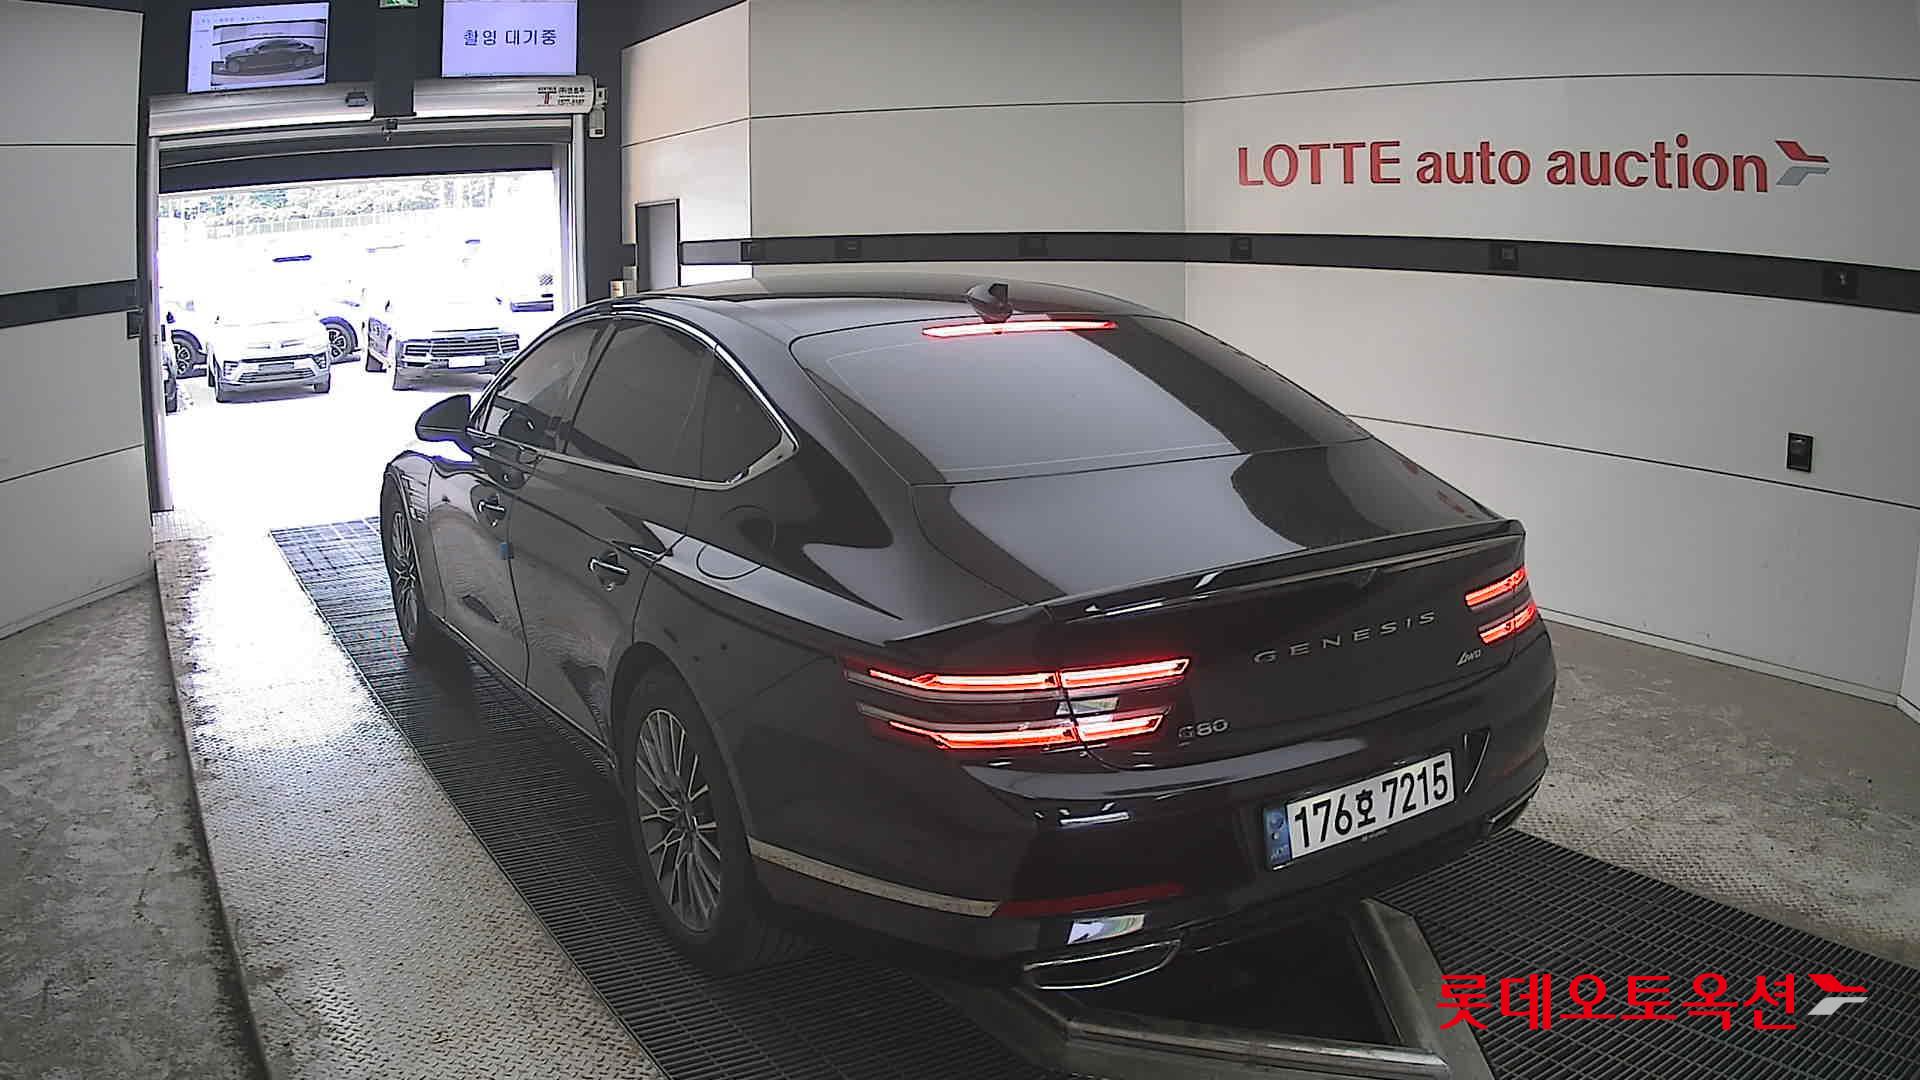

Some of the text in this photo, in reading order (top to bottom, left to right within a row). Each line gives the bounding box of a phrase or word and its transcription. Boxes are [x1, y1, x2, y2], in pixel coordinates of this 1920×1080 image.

[505, 29, 556, 46] 대기중
[1237, 135, 1768, 192] LOTTE auto auction
[1254, 611, 1436, 664] GENESIS
[1178, 719, 1229, 738] G80
[1294, 760, 1448, 848] 176호 7215
